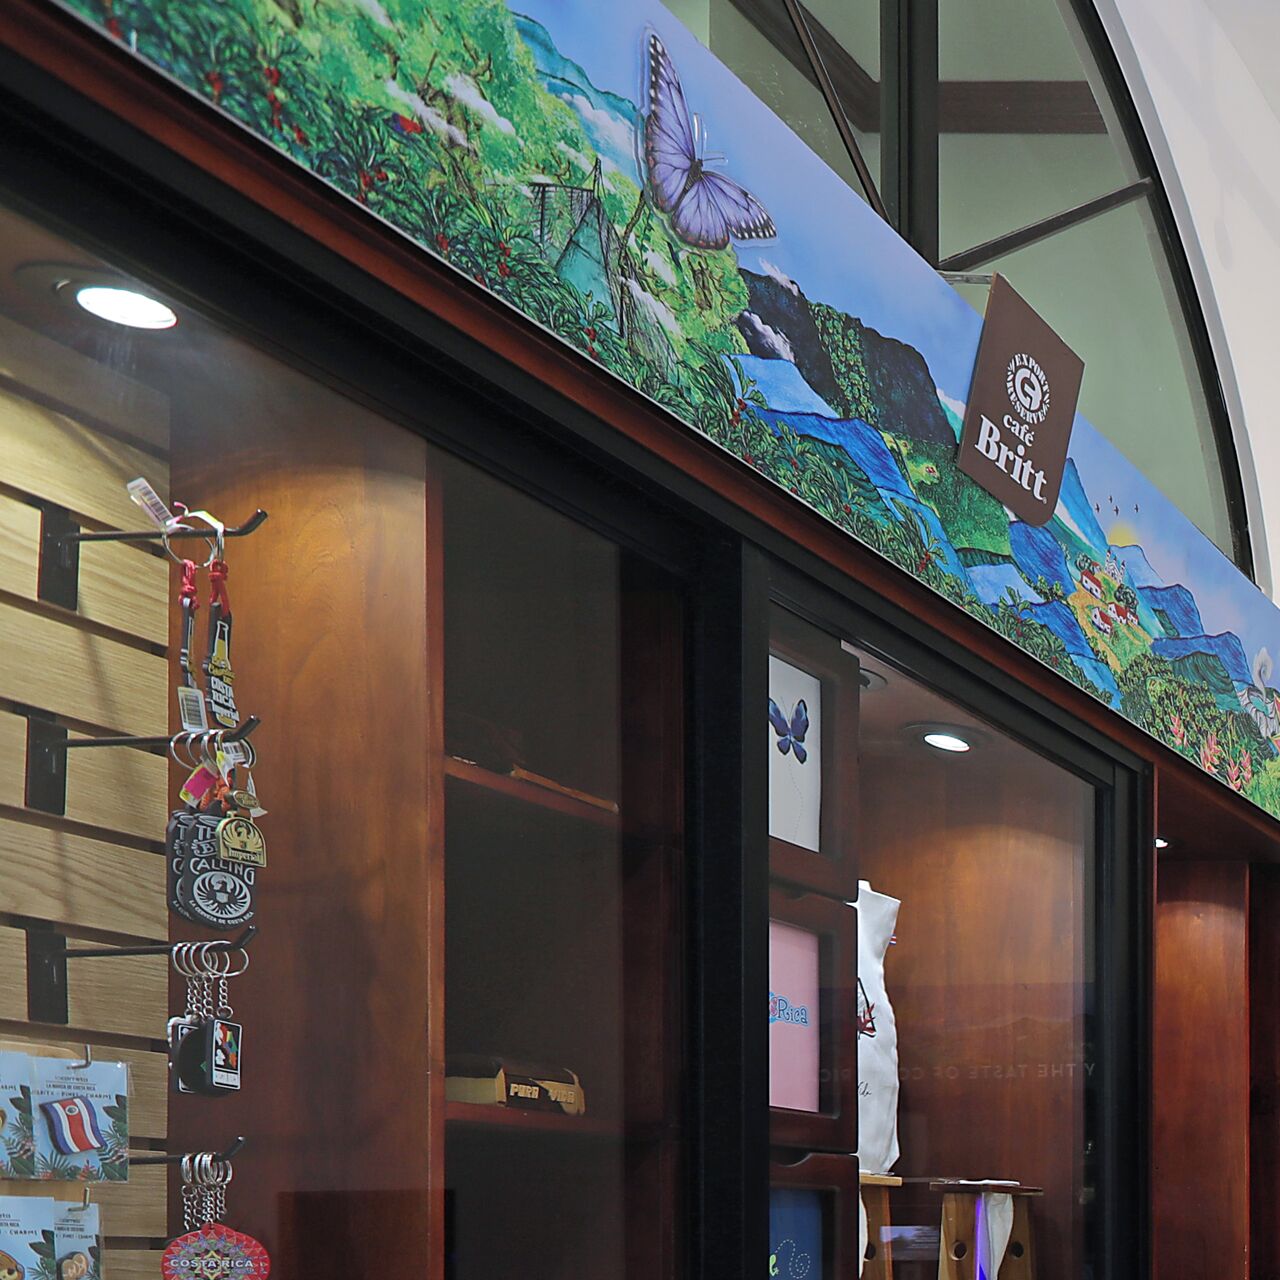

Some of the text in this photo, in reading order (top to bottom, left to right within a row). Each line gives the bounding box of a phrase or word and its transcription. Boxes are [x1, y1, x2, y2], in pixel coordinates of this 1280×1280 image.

[1002, 414, 1034, 447] café
[974, 414, 1047, 502] Britt
[190, 857, 255, 885] CALLING
[777, 997, 809, 1025] Rica
[170, 1259, 254, 1268] COSTA RICA
